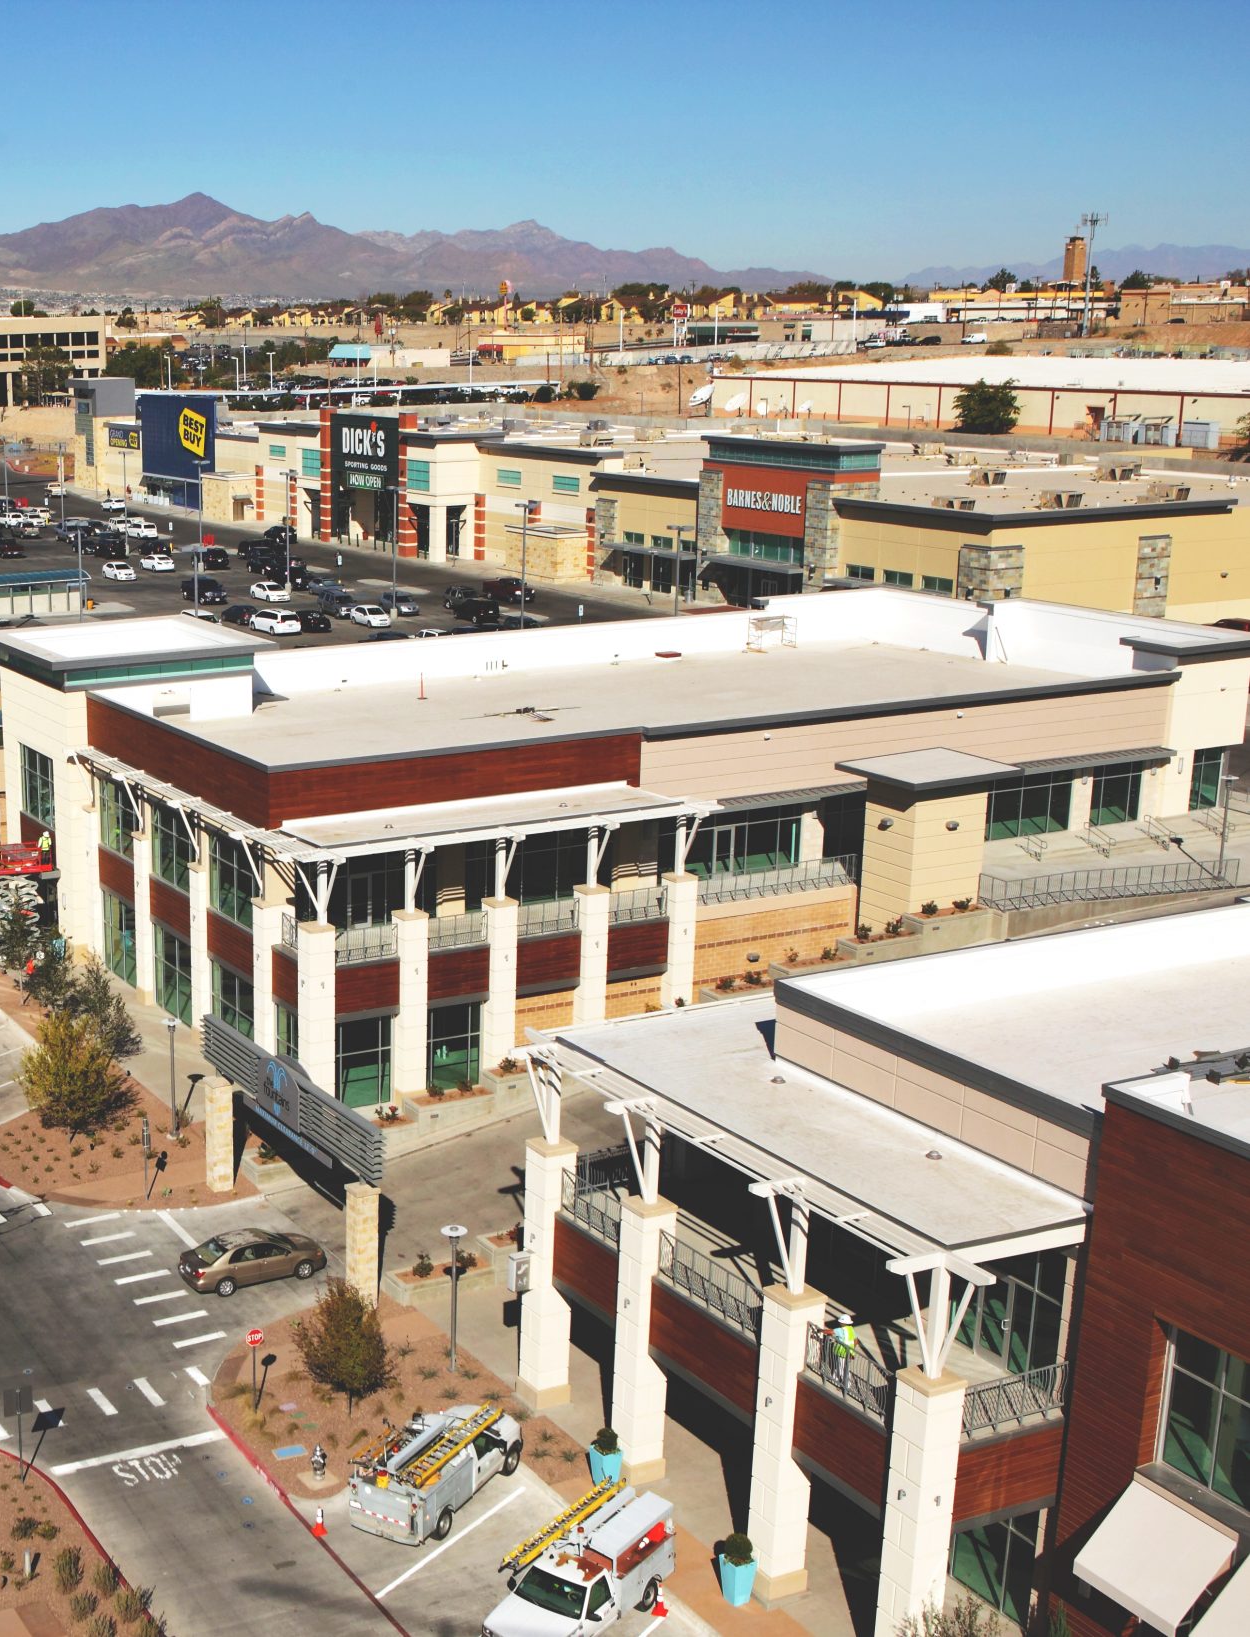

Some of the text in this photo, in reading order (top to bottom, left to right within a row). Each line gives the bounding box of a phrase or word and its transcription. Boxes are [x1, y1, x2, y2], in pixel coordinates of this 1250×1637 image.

[182, 413, 205, 435] BEST
[110, 429, 124, 439] GRAND
[183, 429, 202, 448] BUY
[342, 426, 385, 457] DICK'S
[110, 439, 128, 448] OPENING
[344, 460, 388, 472] SPORTING GOODS
[349, 473, 382, 489] NOW OPEN
[263, 1081, 290, 1112] fountains
[247, 1332, 262, 1343] STOP
[112, 1453, 182, 1488] STOP
